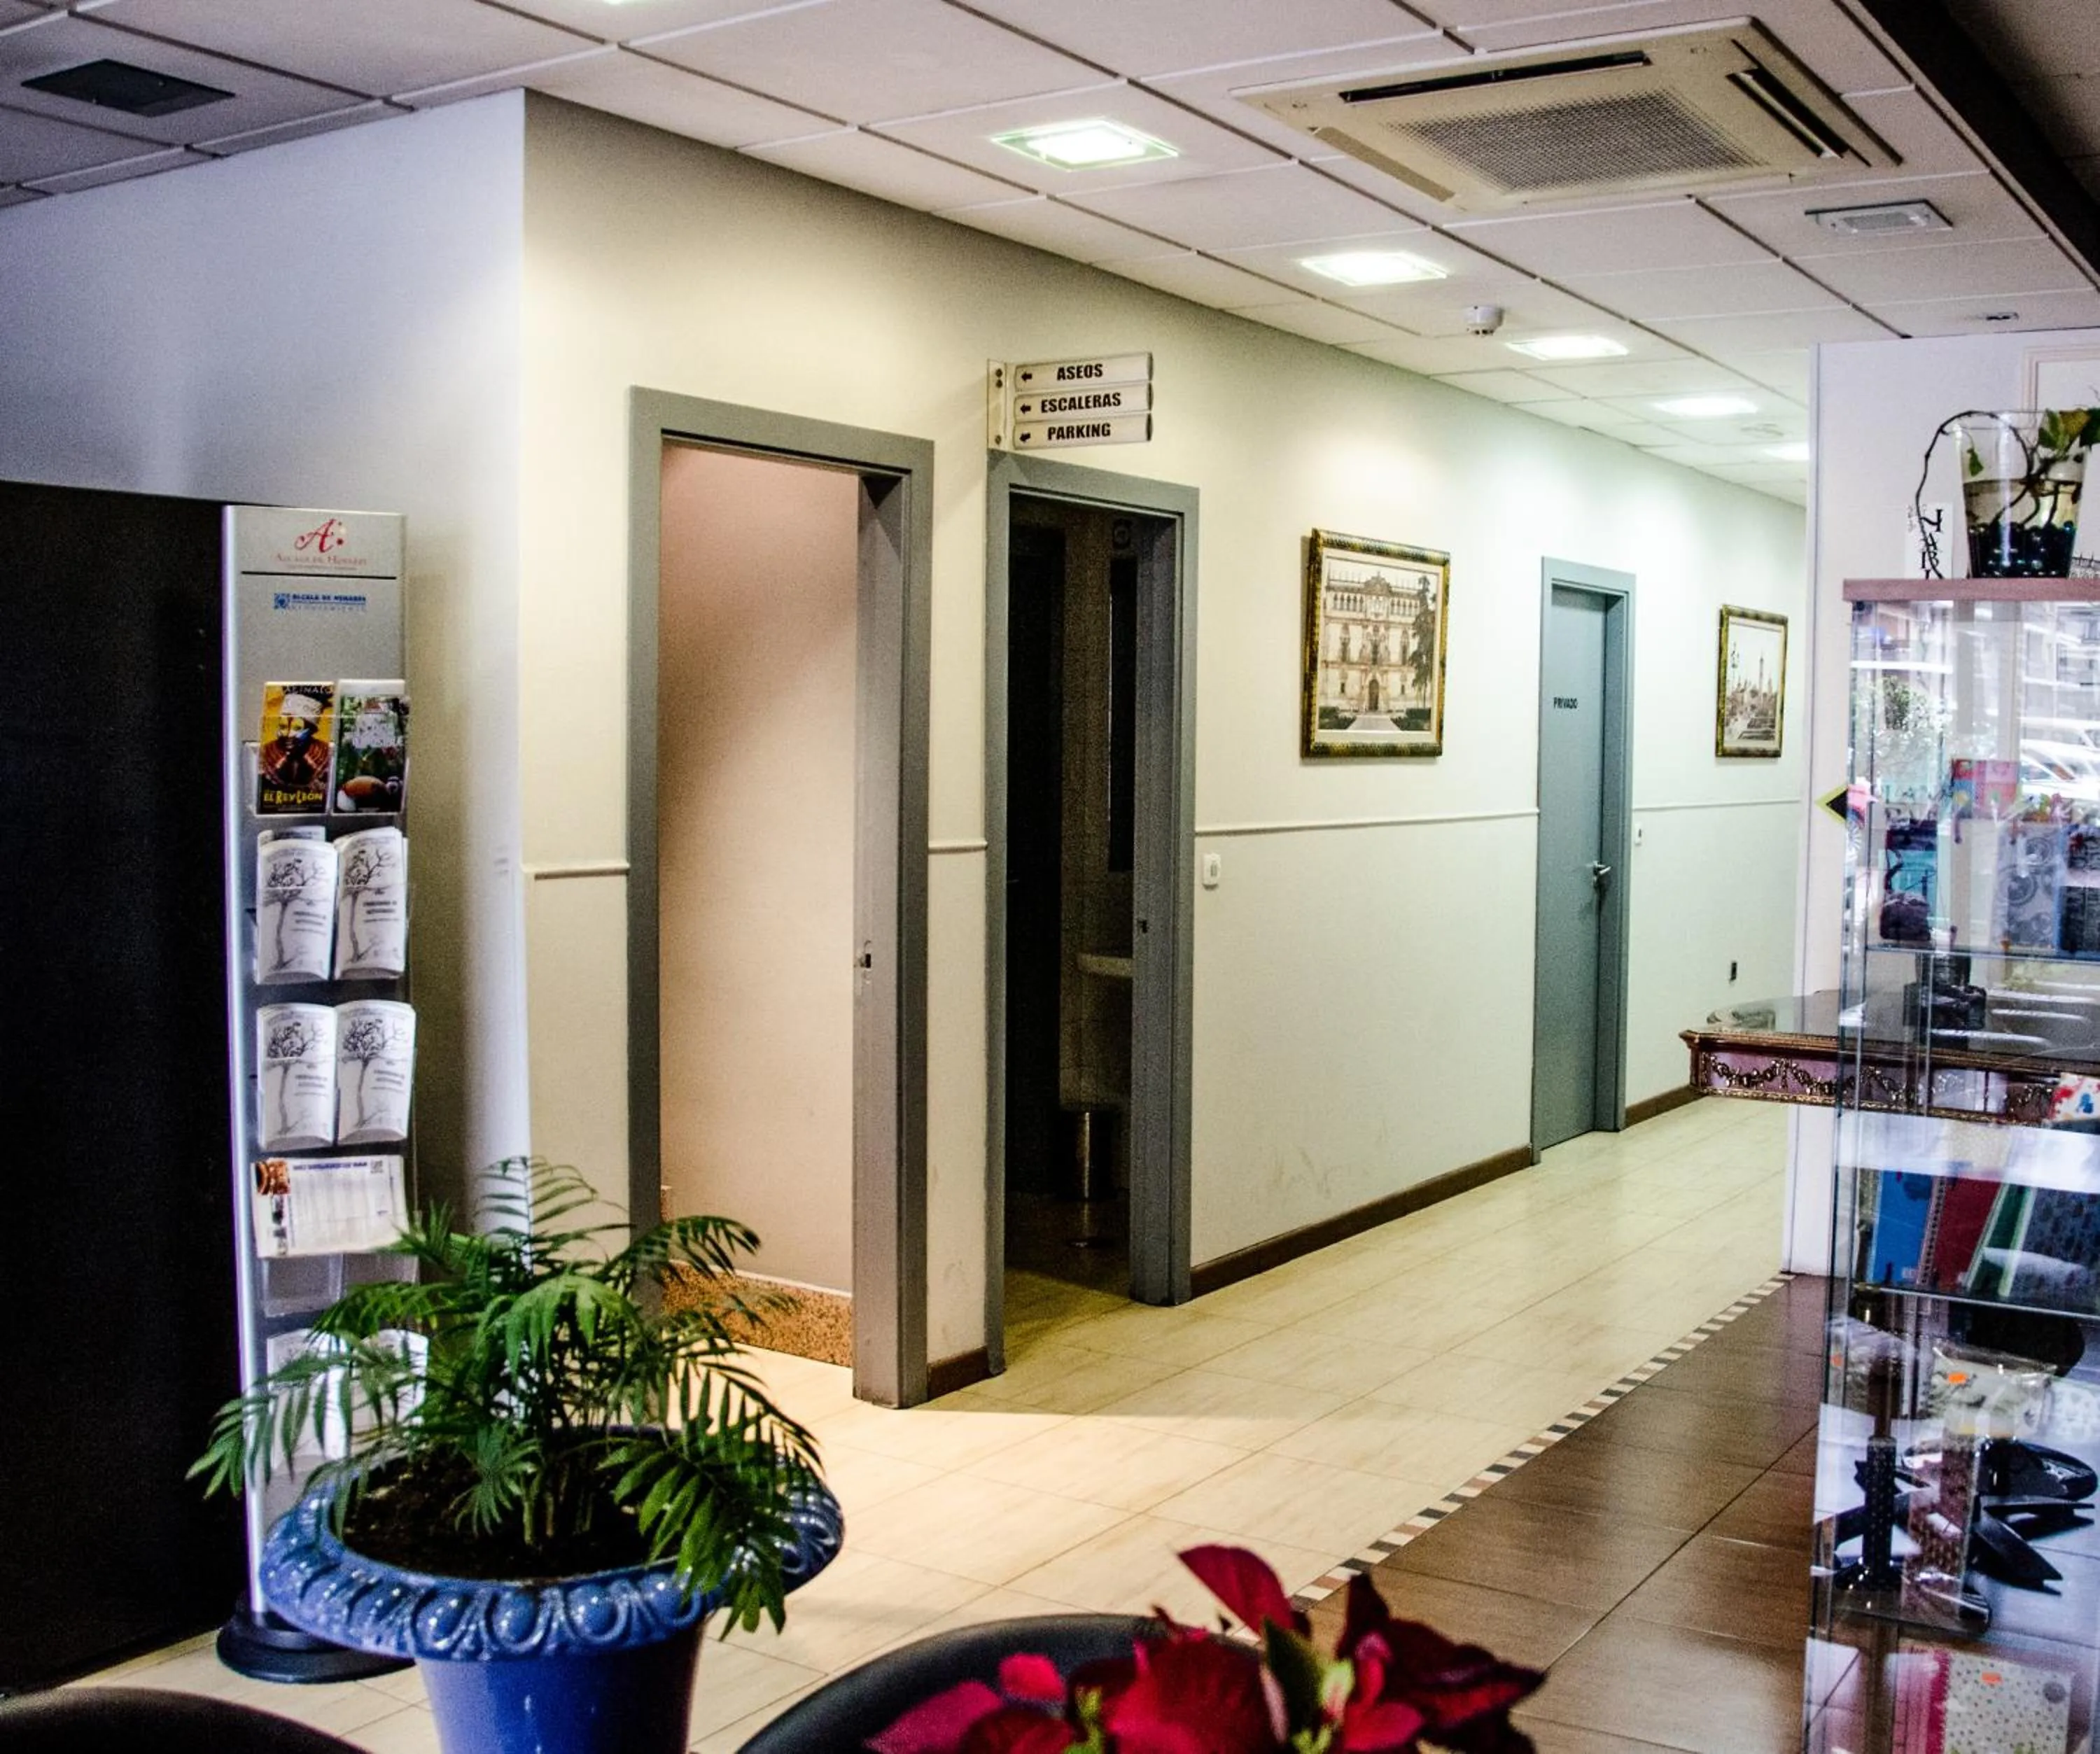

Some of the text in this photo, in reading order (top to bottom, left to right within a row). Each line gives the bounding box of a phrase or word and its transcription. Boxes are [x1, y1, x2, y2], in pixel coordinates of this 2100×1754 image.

[1057, 363, 1103, 381] ASEOS
[1041, 392, 1122, 414] ESCALERAS
[1047, 422, 1112, 440] PARKING
